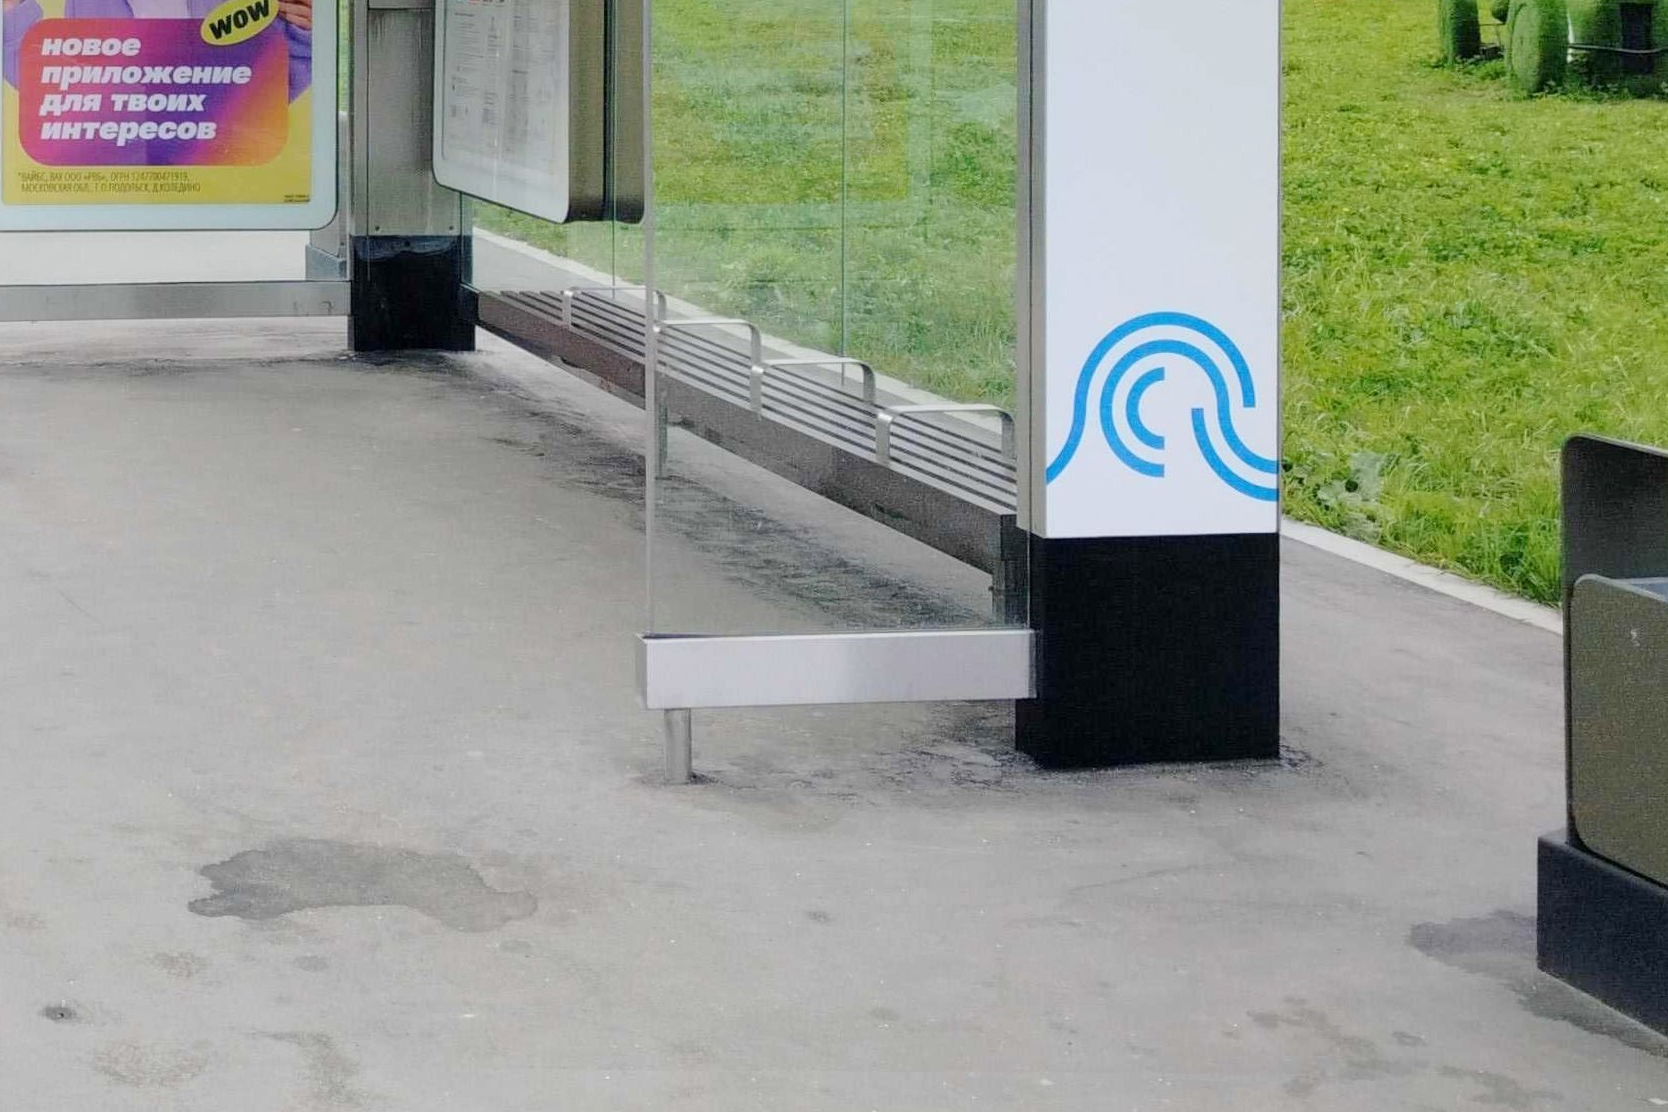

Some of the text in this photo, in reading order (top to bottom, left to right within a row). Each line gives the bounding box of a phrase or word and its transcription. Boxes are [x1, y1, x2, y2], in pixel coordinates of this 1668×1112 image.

[41, 38, 141, 56] новое
[41, 66, 252, 91] приложение
[39, 93, 206, 116] для твоих
[40, 121, 217, 147] интересов
